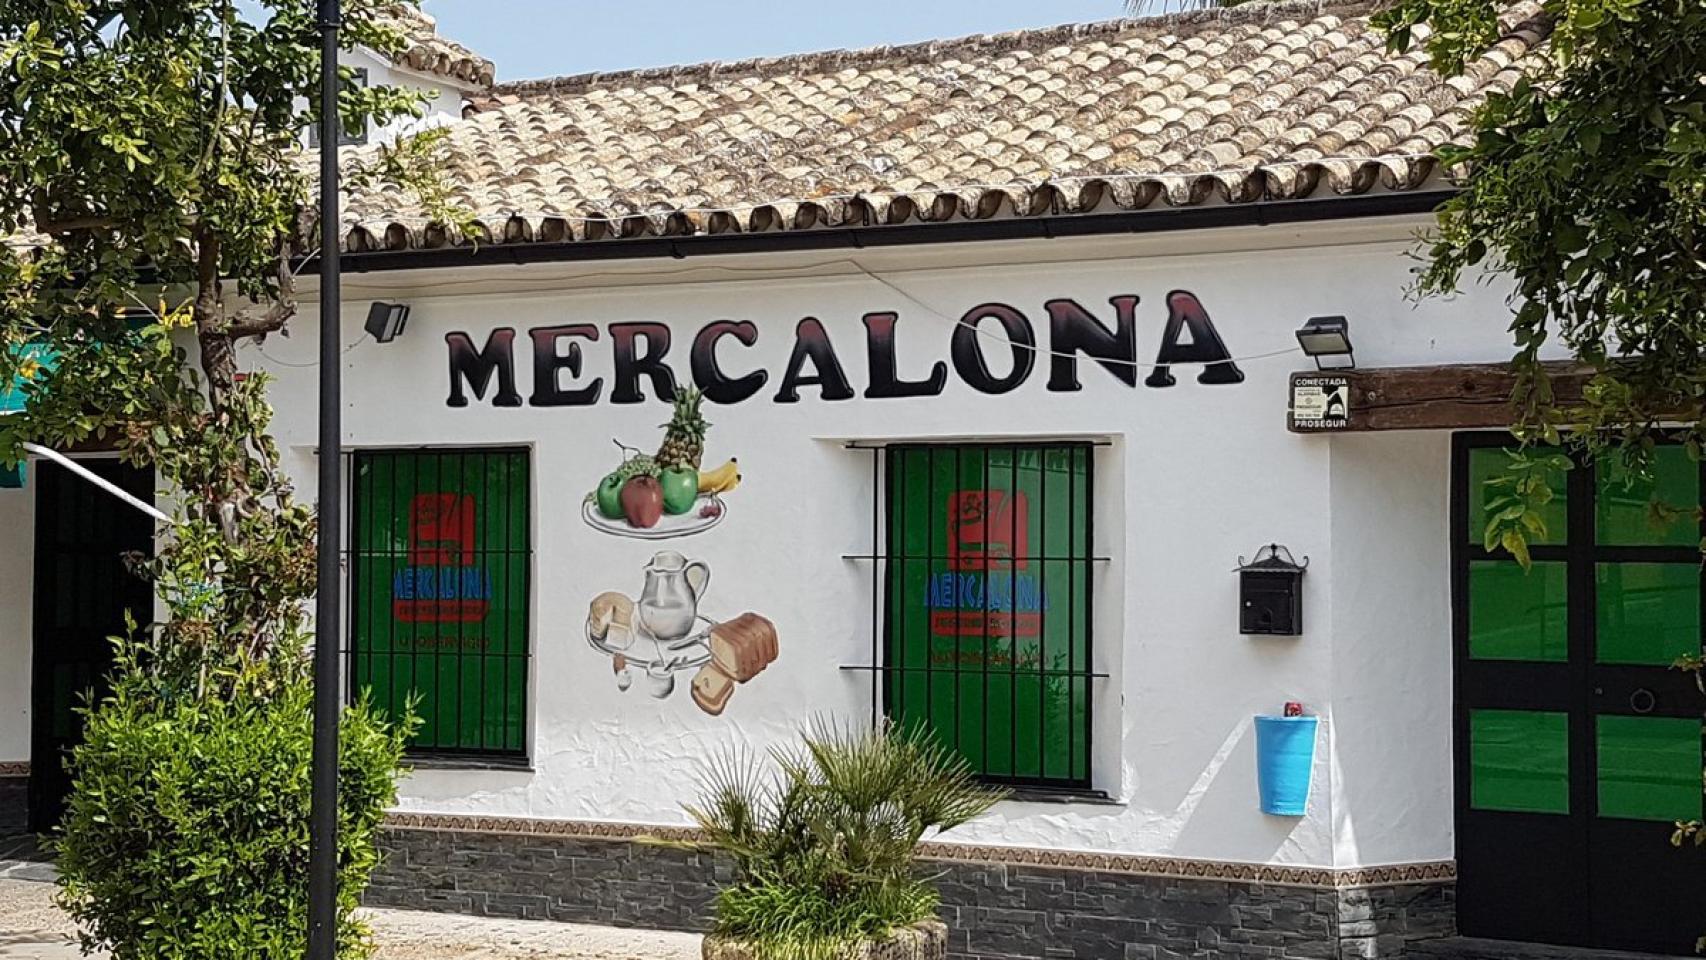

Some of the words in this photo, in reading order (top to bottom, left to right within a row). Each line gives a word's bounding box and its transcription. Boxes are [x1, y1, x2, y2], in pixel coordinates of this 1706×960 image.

[445, 290, 1244, 407] MERCALONA
[1295, 377, 1347, 386] CONECTADA
[1294, 419, 1346, 428] PROSEGUR
